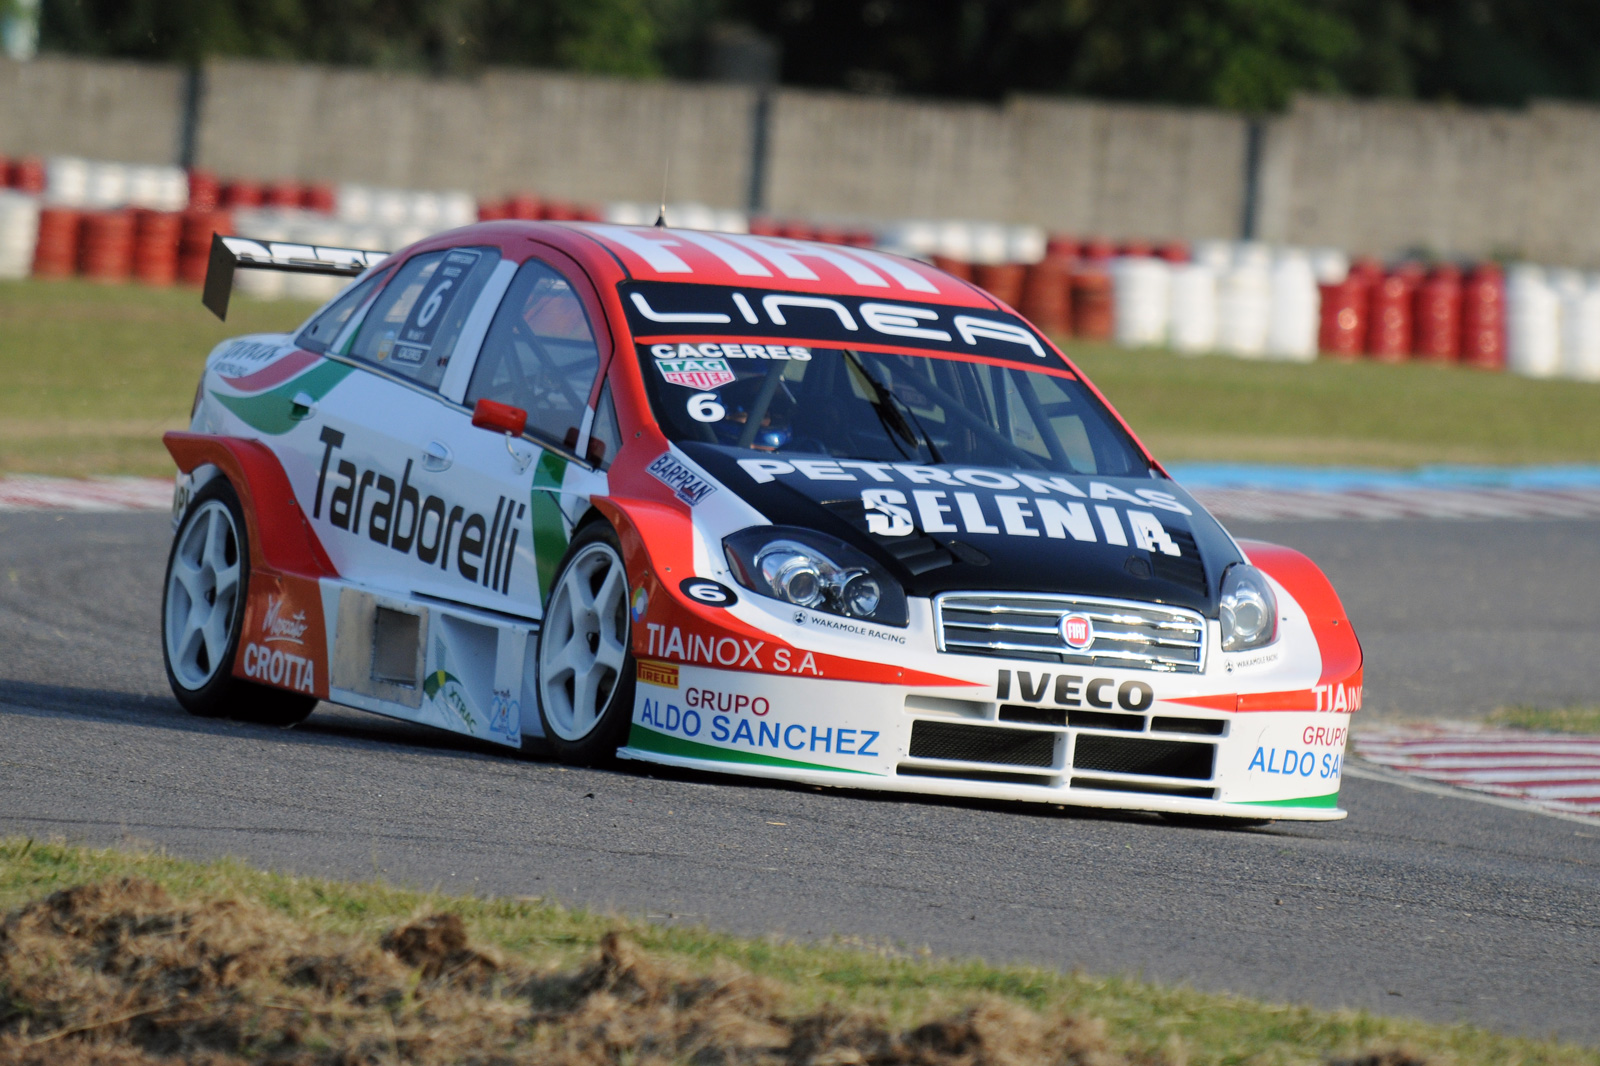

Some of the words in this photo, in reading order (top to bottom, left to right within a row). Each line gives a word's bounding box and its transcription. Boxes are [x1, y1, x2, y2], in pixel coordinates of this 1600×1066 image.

[588, 226, 941, 295] FIAT
[416, 279, 453, 329] 6
[629, 292, 1047, 359] LINEA
[650, 343, 813, 362] CACERES
[662, 361, 723, 372] TAG
[667, 372, 735, 389] HEUER
[686, 392, 726, 423] 6
[650, 455, 713, 503] BARPRAN
[736, 458, 1193, 517] PETRONAS
[313, 424, 527, 597] Taraborelli
[860, 488, 1182, 557] SELENIA
[688, 584, 728, 602] 6
[647, 622, 764, 669] TIAINOX
[773, 649, 824, 676] S.A.
[811, 616, 867, 637] WAKAMOLE
[867, 628, 907, 645] RACING
[1067, 622, 1087, 640] FIAT
[243, 641, 315, 695] CROTTA
[637, 661, 679, 686] PIRELLI
[995, 668, 1154, 712] IVECO
[449, 685, 478, 734] XTRAC
[685, 687, 770, 717] GRUPO
[641, 697, 701, 737] ALDO
[710, 714, 880, 757] SANCHEZ
[1302, 726, 1347, 747] GRUPO
[1248, 746, 1316, 778] ALDO
